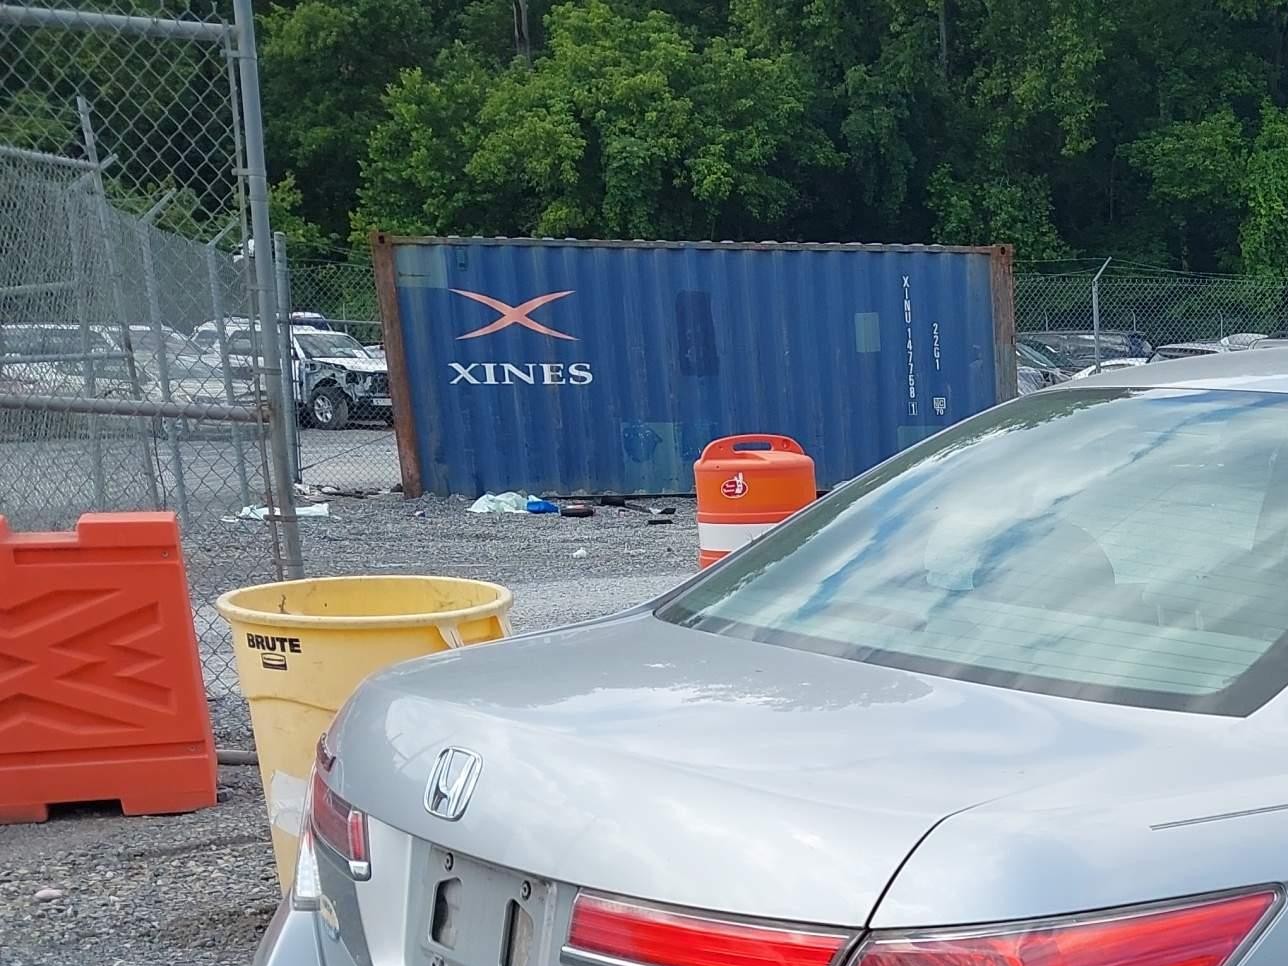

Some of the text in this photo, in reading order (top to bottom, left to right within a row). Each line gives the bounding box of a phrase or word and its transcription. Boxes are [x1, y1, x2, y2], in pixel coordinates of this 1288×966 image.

[902, 275, 912, 324] XINU
[932, 322, 941, 371] 22G1
[448, 362, 593, 385] XINES
[246, 632, 302, 653] BRUTE
